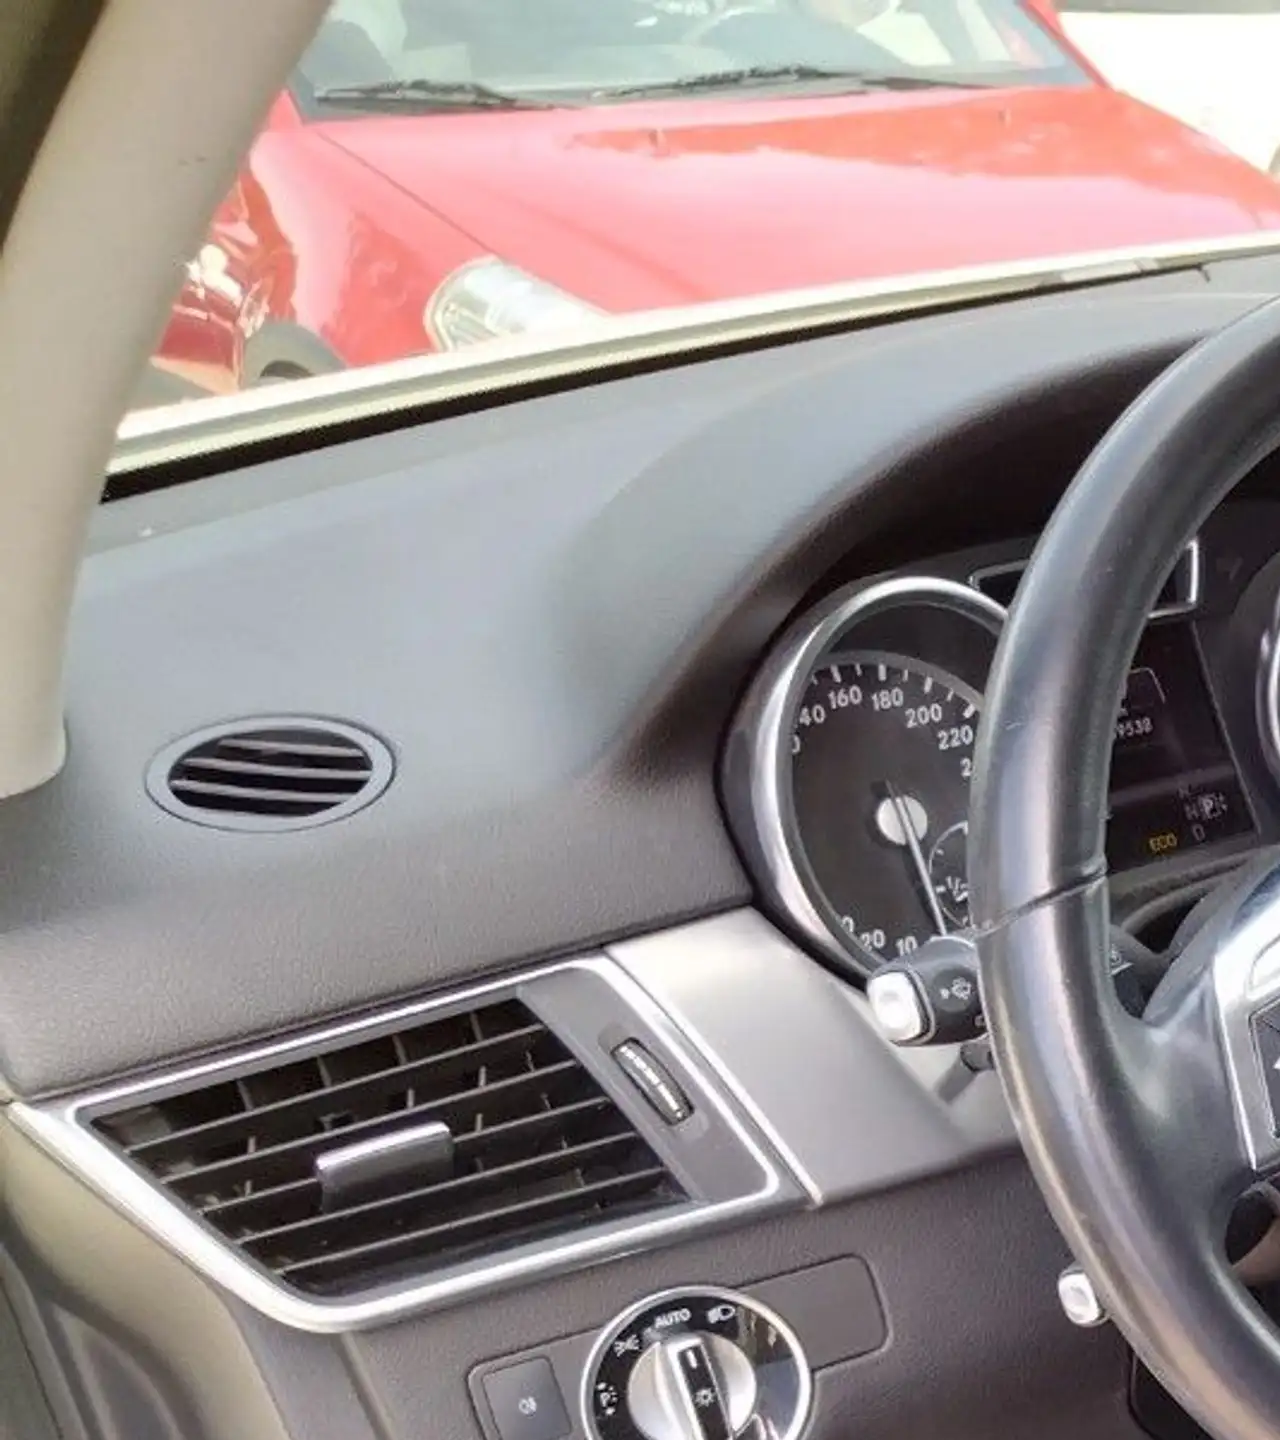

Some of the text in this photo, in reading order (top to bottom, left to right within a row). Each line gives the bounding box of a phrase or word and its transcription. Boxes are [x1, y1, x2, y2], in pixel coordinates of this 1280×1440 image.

[828, 685, 863, 710] 160
[871, 687, 904, 711] 180
[799, 704, 826, 726] 40
[904, 703, 943, 729] 200
[937, 725, 974, 750] 220
[1149, 832, 1178, 852] ECO
[654, 1307, 692, 1329] AUTO
